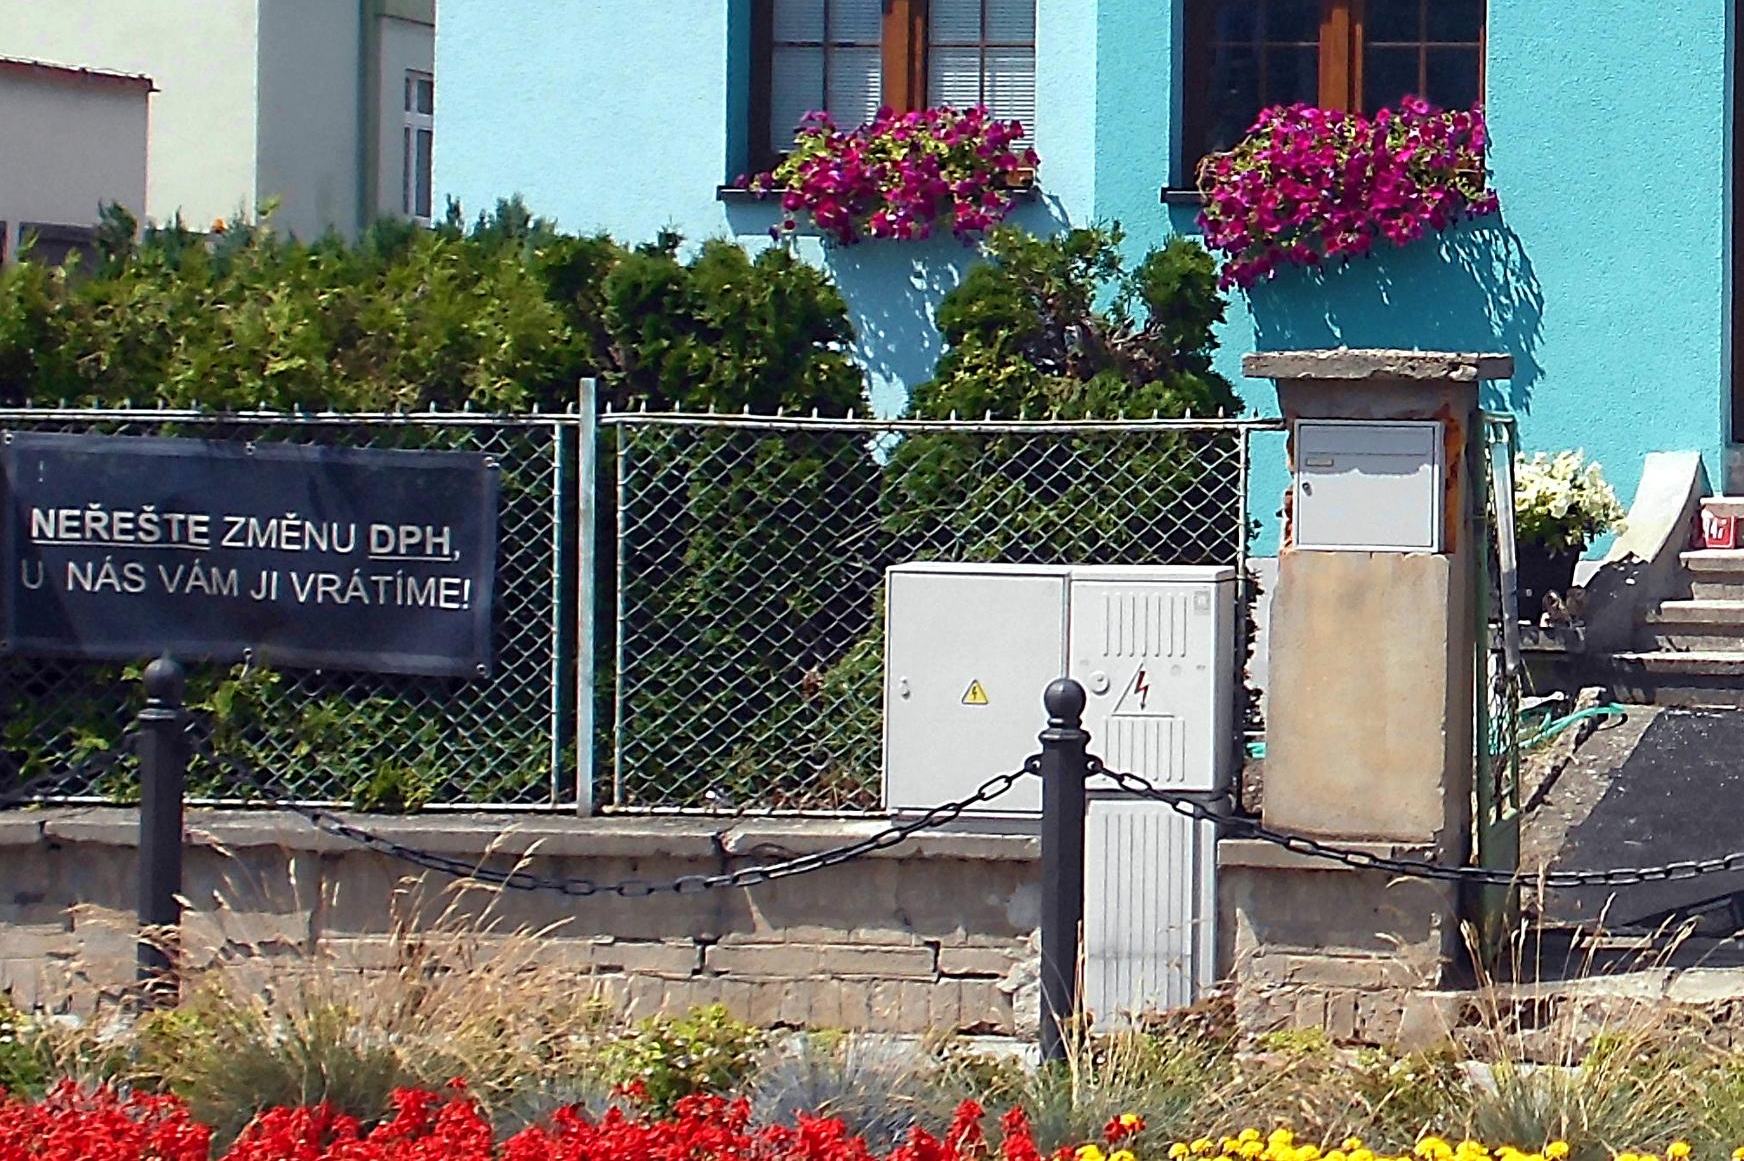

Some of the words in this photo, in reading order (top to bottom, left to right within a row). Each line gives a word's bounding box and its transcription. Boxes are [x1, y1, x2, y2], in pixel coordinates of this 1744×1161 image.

[31, 503, 211, 544] NEŘEŠTE
[221, 512, 356, 554] ZMĚNU
[369, 523, 461, 561] DPH,
[21, 560, 44, 589] U
[67, 555, 146, 593] NÁS
[158, 560, 240, 597] VÁM
[250, 570, 278, 601] JI
[289, 569, 471, 610] VRÁTÍME!
